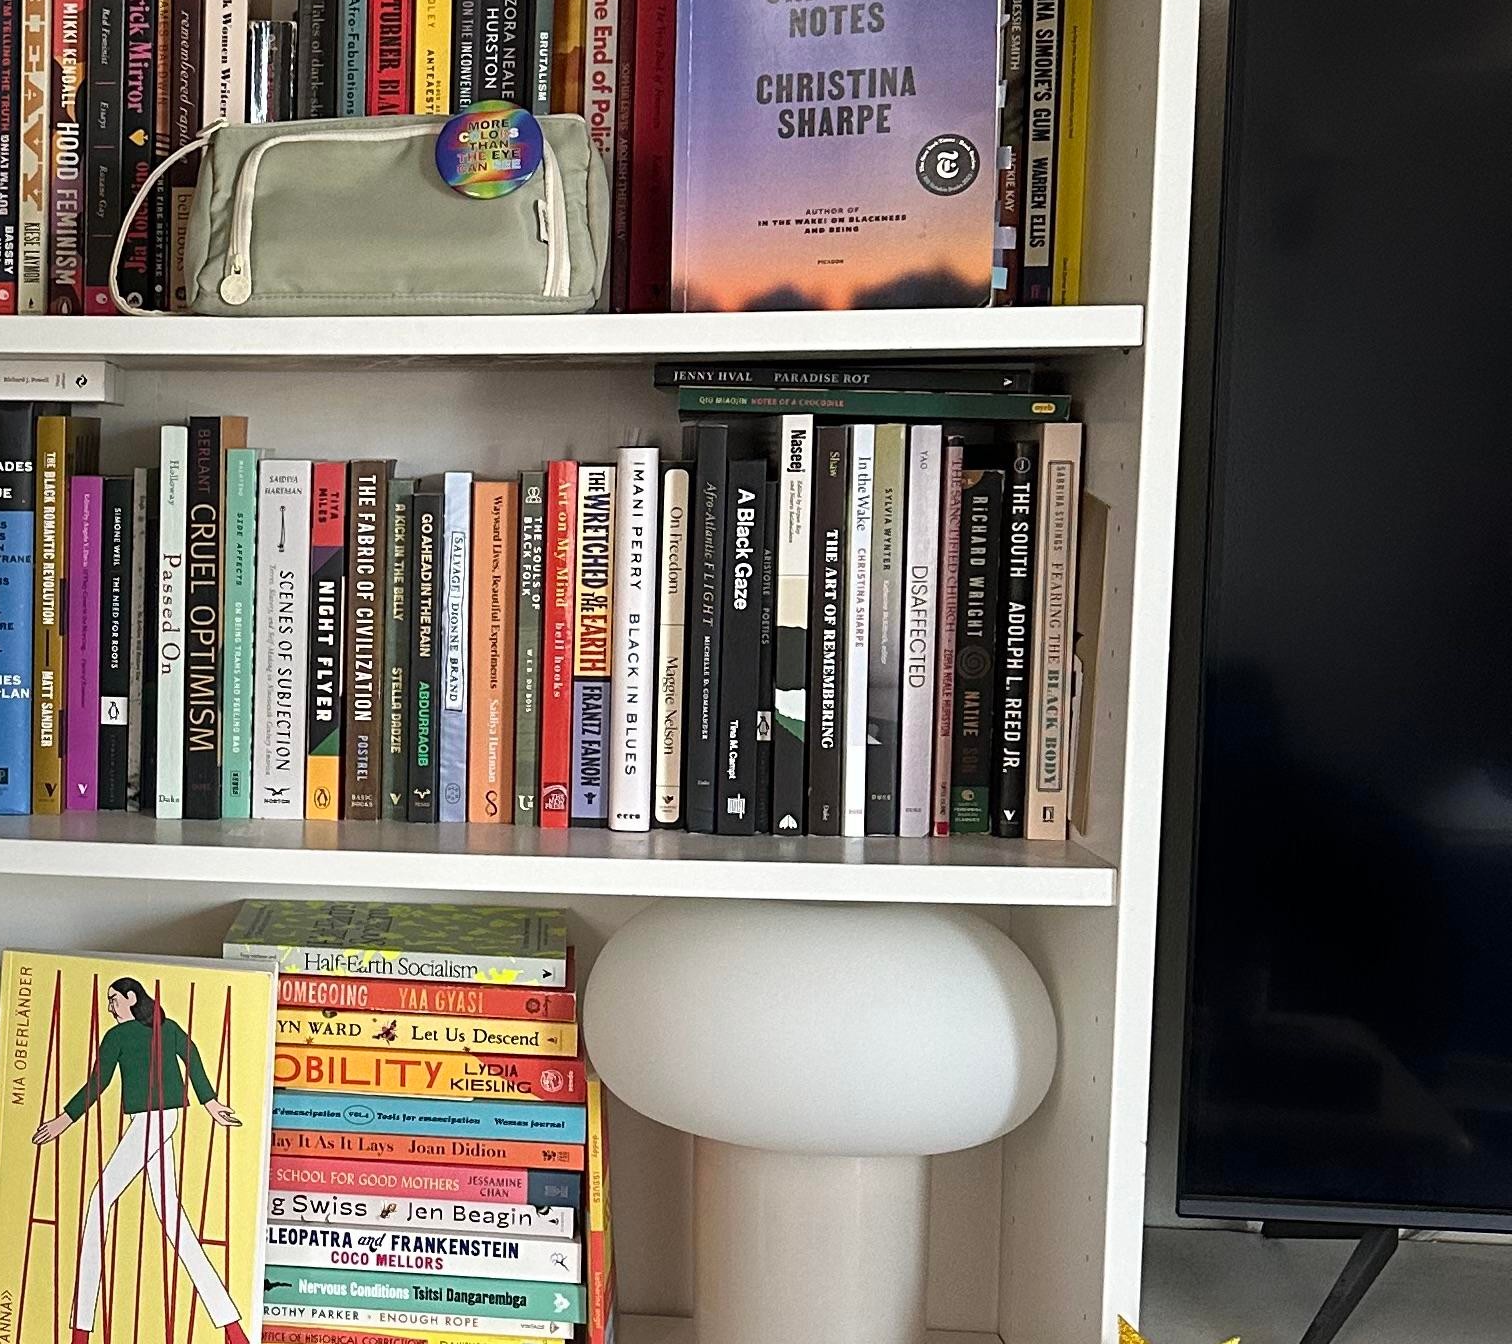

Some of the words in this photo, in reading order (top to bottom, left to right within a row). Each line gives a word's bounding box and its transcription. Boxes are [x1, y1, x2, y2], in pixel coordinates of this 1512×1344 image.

[62, 3, 79, 43] MIKKI
[789, 2, 885, 38] NOTES
[484, 7, 499, 90] HURSTON
[538, 32, 549, 101] BRUTALISM
[61, 48, 77, 108] KENDALL
[128, 43, 152, 113] Mirror
[756, 65, 916, 105] CHRISTINA
[778, 104, 891, 139] SHARPE
[1033, 105, 1051, 142] GUM
[55, 121, 79, 180] HOOD
[1031, 157, 1050, 210] WARREN
[55, 188, 78, 284] FEMINISM
[1030, 214, 1046, 249] ELLIS
[358, 475, 376, 506] THE
[632, 462, 644, 518] IMANI
[738, 488, 755, 505] A
[1013, 482, 1030, 513] THE
[189, 504, 217, 595] CRUEL
[357, 510, 375, 576] FABRIC
[736, 507, 754, 557] Black
[1010, 517, 1028, 578] SOUTH
[631, 529, 643, 591] PERRY
[734, 559, 752, 611] Gaze
[316, 580, 335, 647] NIGHT
[356, 581, 374, 600] OF
[628, 613, 641, 679] BLACK
[910, 566, 928, 689] DISAFFECTED
[188, 604, 217, 752] OPTIMISM
[354, 605, 374, 722] CIVILIZATION
[315, 658, 333, 723] FLYER
[626, 686, 638, 703] IN
[624, 713, 637, 776] BLUES
[304, 953, 393, 975] Half-Earth
[398, 958, 478, 979] Socialism
[14, 967, 32, 1070] OBERLÄNDER
[399, 988, 430, 1010] YAA
[434, 991, 484, 1013] GYASI
[411, 1026, 439, 1042] Let
[445, 1027, 466, 1043] Us
[472, 1029, 539, 1047] Descend
[12, 1075, 24, 1105] MIA
[407, 1202, 447, 1223] Jen
[453, 1204, 533, 1227] Beagin
[330, 1251, 369, 1265] COCO
[376, 1254, 443, 1270] MELLORS
